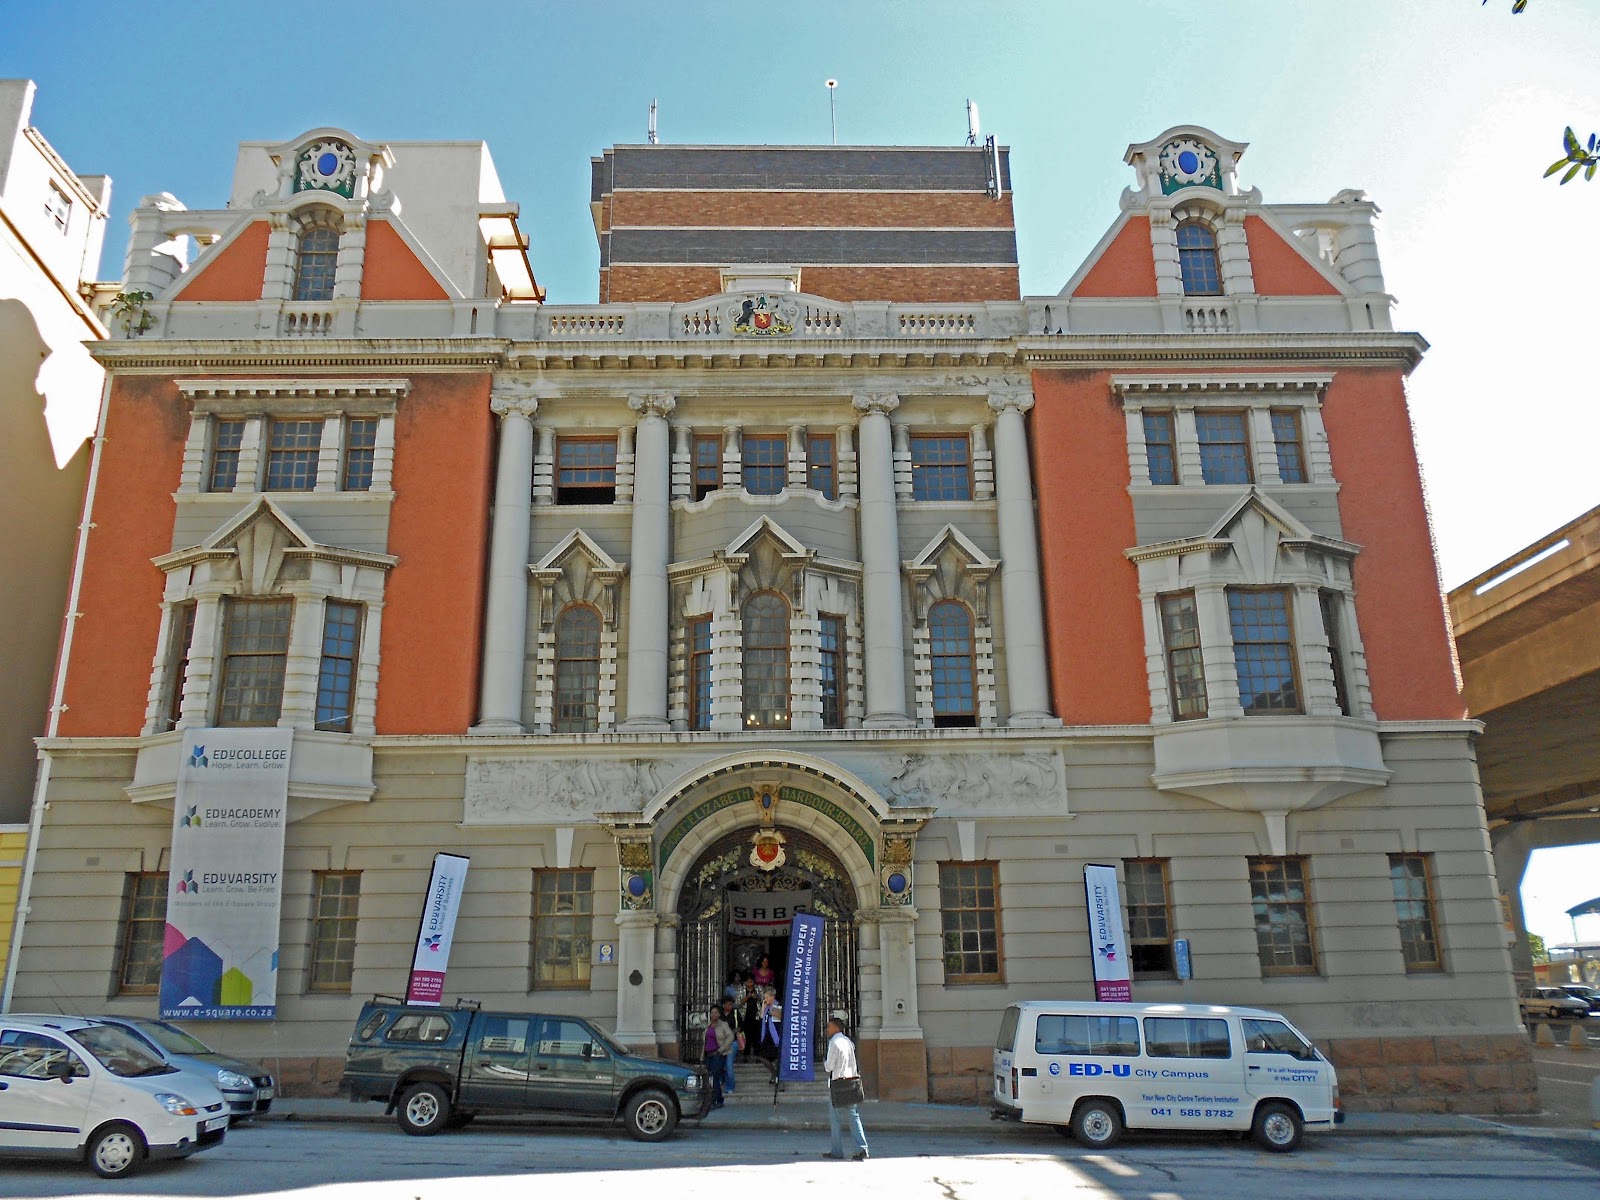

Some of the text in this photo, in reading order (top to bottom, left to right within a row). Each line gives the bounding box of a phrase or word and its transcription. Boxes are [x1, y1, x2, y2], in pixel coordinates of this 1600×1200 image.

[663, 788, 869, 849] PORT ELIZABETH HARBOUR BOARD
[803, 926, 817, 1007] www.e-square.co.za
[789, 923, 808, 1071] REGISTRATION NOW OPEN
[163, 1008, 273, 1019] www.e-square.co.za
[1069, 1063, 1209, 1079] ED-U City Campus
[1166, 1094, 1176, 1103] City
[1177, 1094, 1194, 1102] Centre
[1194, 1095, 1213, 1104] Tertiary
[1151, 1108, 1234, 1118] 041 585 8782
